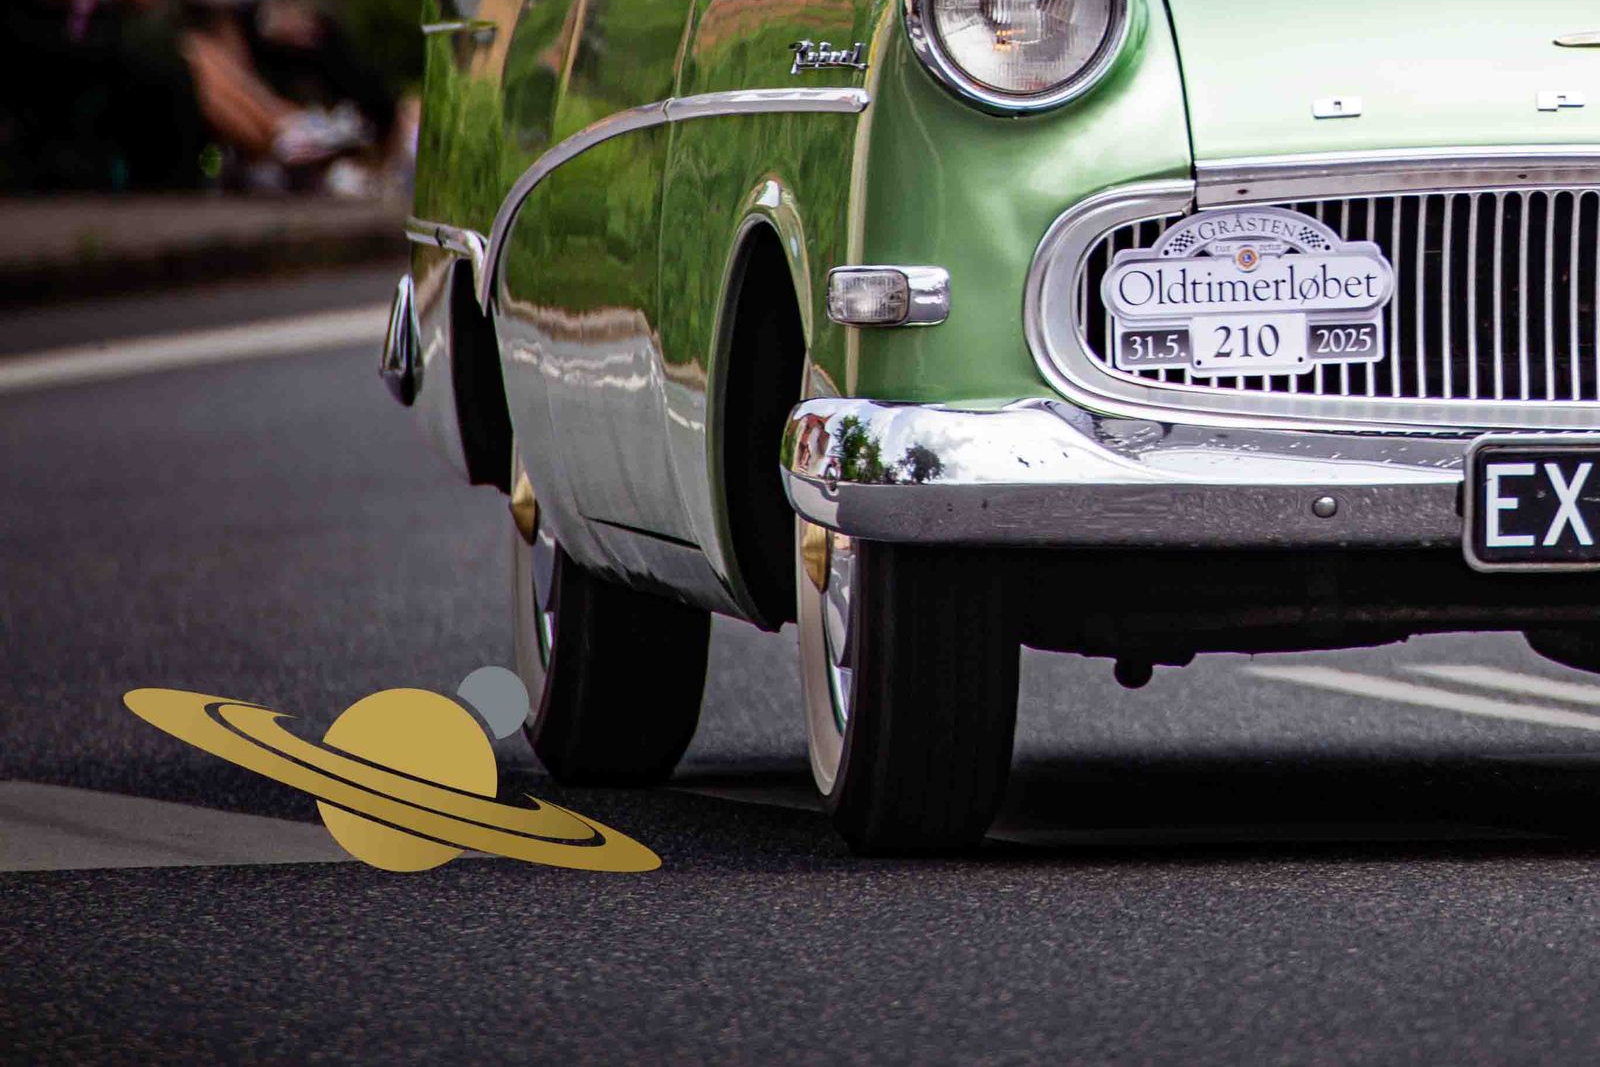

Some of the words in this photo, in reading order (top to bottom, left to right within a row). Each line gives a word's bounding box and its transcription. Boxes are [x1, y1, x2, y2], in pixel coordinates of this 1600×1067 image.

[1198, 213, 1297, 241] GRÅSTEN
[1118, 263, 1378, 306] Oldtimerløbet
[1128, 334, 1187, 360] 31.5.
[1213, 323, 1280, 359] 210
[1315, 327, 1373, 354] 2025
[1485, 462, 1594, 548] EX
